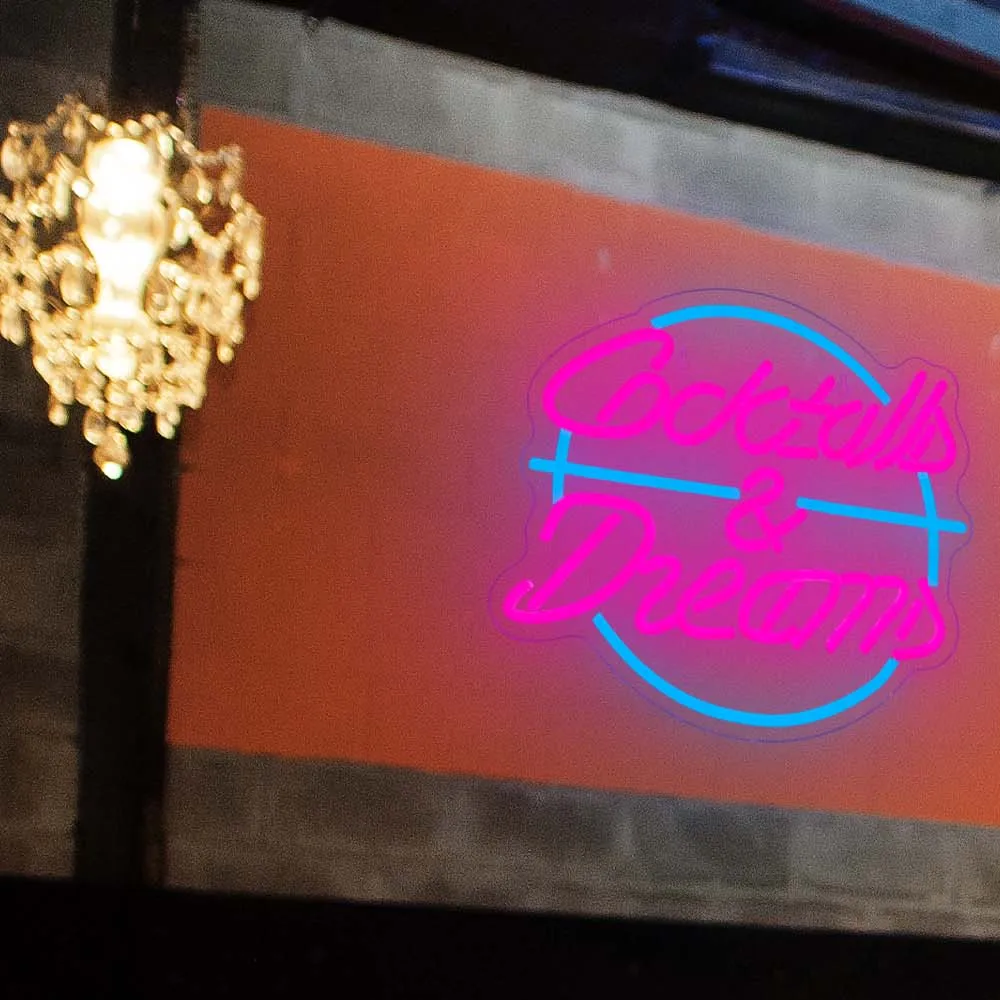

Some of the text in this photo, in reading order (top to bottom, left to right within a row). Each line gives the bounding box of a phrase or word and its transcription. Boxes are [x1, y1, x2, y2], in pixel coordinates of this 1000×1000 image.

[542, 327, 956, 474] Cocktails
[503, 492, 946, 661] Dreams
[725, 467, 808, 553] &
